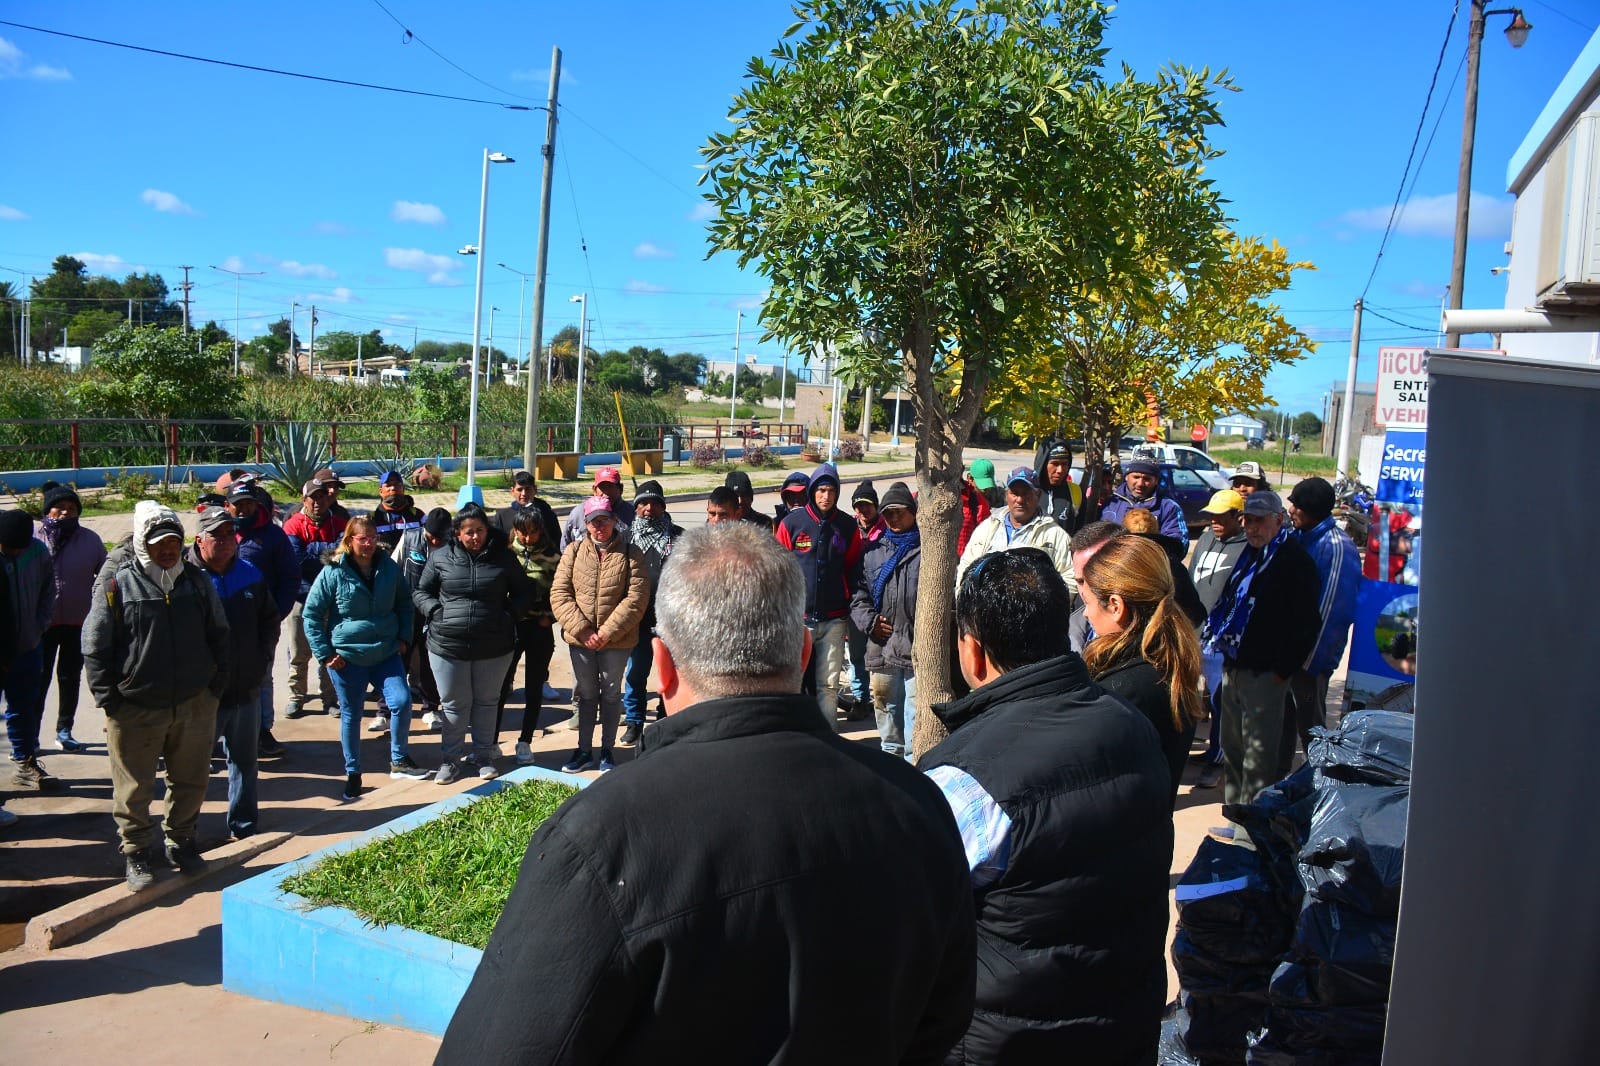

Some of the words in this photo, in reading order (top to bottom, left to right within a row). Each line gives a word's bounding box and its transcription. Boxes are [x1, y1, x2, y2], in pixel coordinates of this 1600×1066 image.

[1382, 352, 1429, 375] ¡¡CU
[1398, 392, 1427, 403] SAL
[1382, 407, 1426, 423] VEHI
[1384, 443, 1426, 463] Secre
